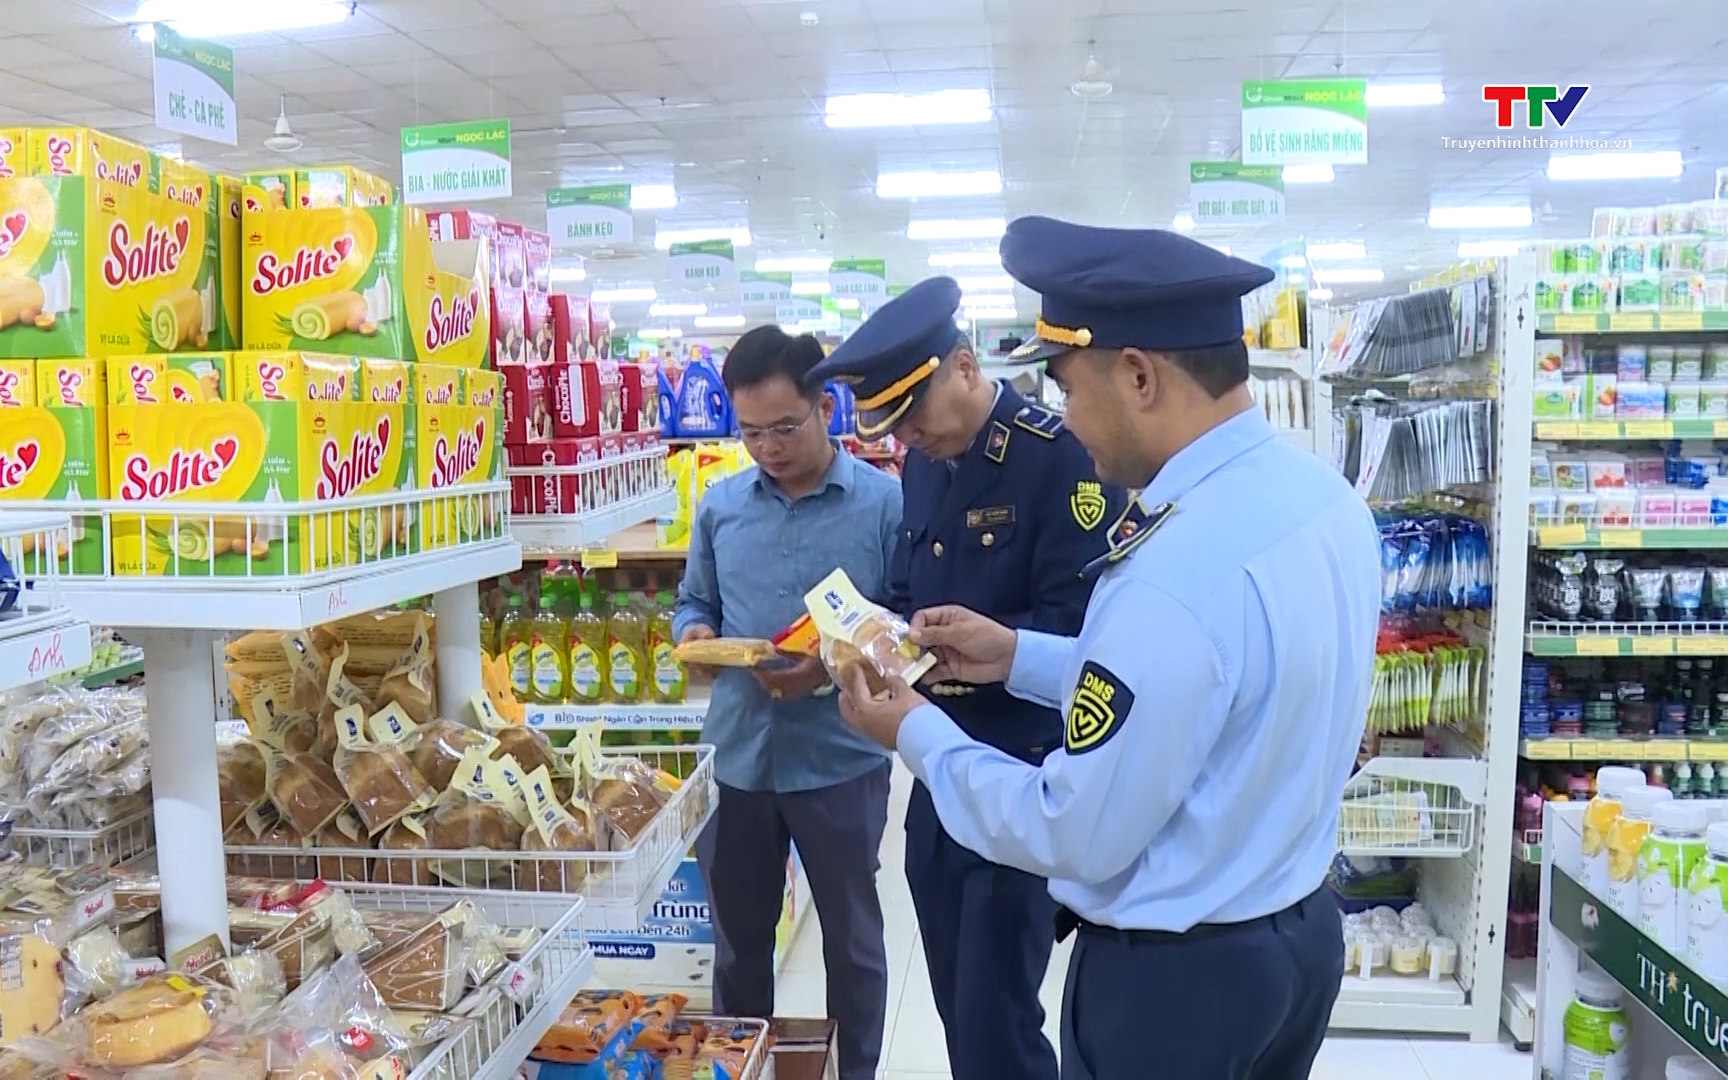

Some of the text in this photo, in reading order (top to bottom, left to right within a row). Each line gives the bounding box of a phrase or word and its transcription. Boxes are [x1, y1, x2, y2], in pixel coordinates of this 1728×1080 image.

[1304, 90, 1337, 103] NGỌC
[456, 131, 484, 144] NGỌC
[486, 129, 505, 141] LẠC
[1280, 133, 1301, 152] SINH
[408, 175, 424, 192] BIA
[432, 167, 459, 191] NƯỚC
[482, 164, 506, 188] KHÁT
[595, 221, 613, 239] KẸO
[103, 222, 178, 287] Solite
[253, 249, 338, 294] Solite
[426, 296, 472, 351] Solite
[316, 433, 380, 501] Solite
[431, 432, 478, 488] Solite
[121, 451, 220, 501] Solite
[1077, 481, 1101, 494] DMS
[1083, 671, 1115, 702] DMS
[619, 947, 649, 956] NGAY
[1636, 952, 1667, 1006] TH
